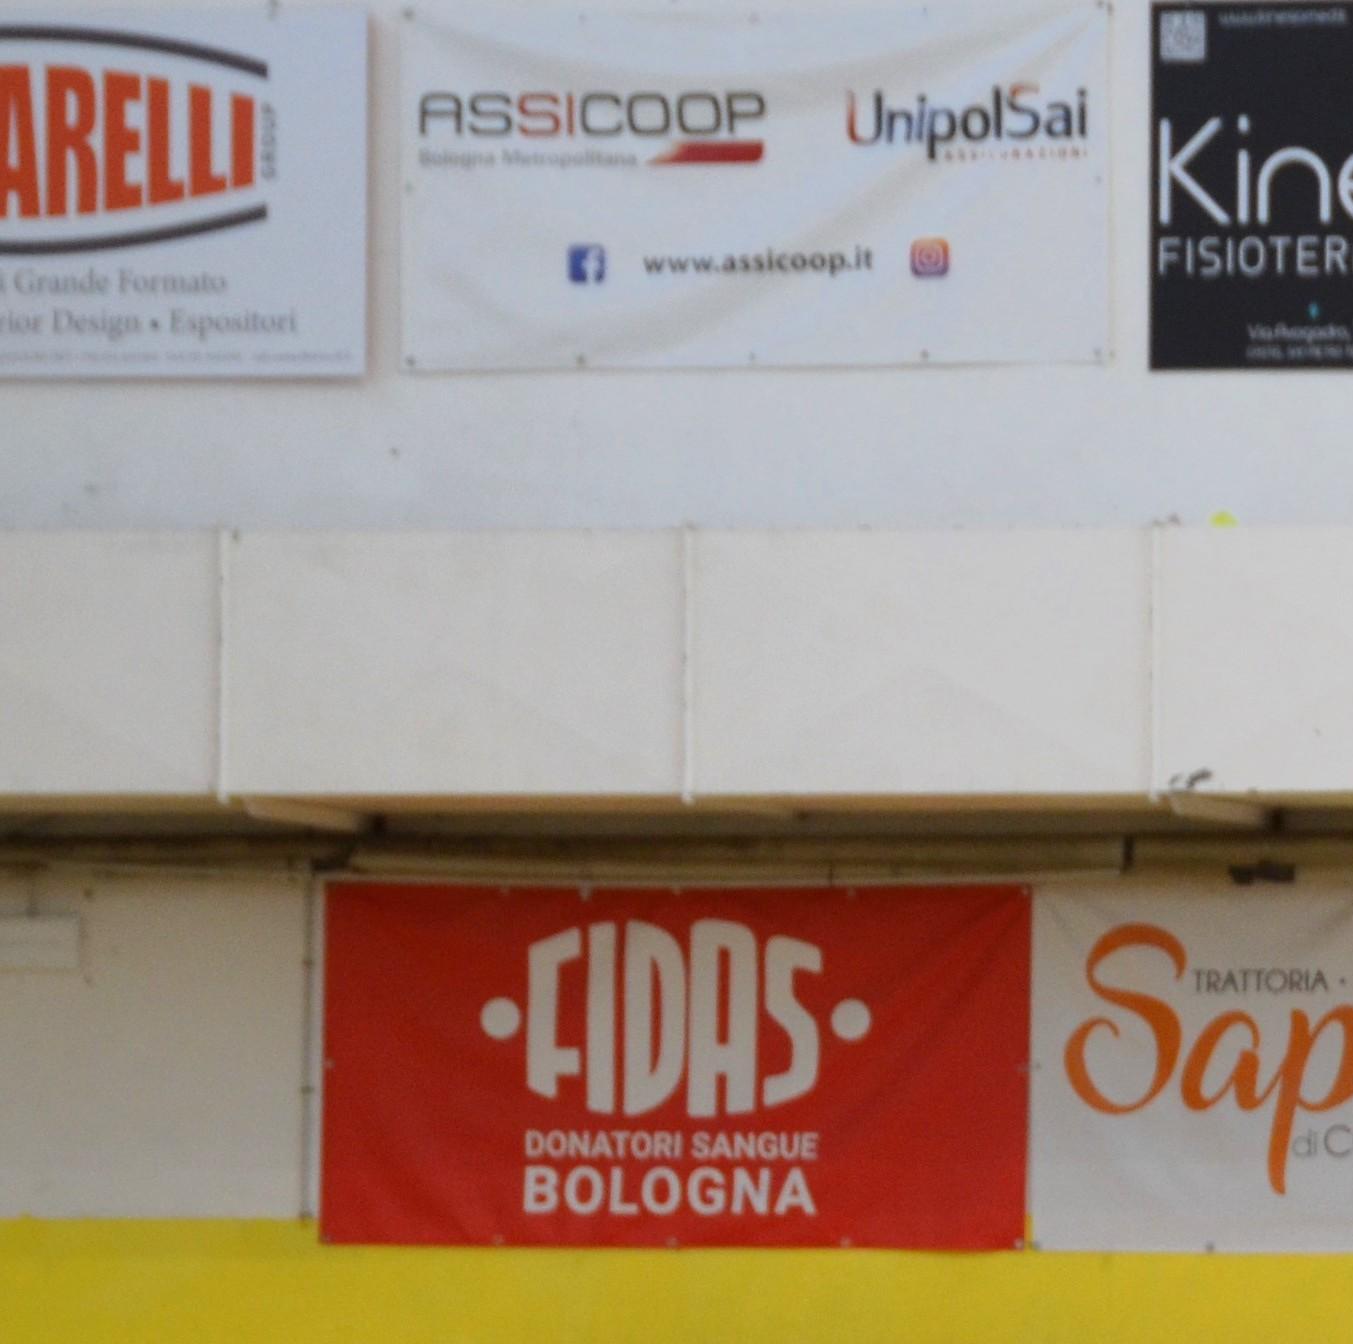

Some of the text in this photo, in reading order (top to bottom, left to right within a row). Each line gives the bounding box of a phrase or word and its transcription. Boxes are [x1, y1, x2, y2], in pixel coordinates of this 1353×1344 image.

[418, 92, 767, 137] ASSICOOP
[846, 82, 1088, 159] UnipolSai
[418, 148, 638, 170] Bologna Metropolitana
[643, 245, 873, 277] www.assicoop.it
[14, 268, 110, 296] Grande
[118, 267, 227, 296] Formato
[51, 308, 141, 340] Design
[168, 307, 297, 341] Espositori
[1193, 967, 1329, 994] TRATTORIA
[526, 918, 823, 1119] FIDAS
[523, 1128, 820, 1162] DONATORI SANGUE
[1291, 1134, 1319, 1159] di
[522, 1164, 817, 1217] BOLOGNA
